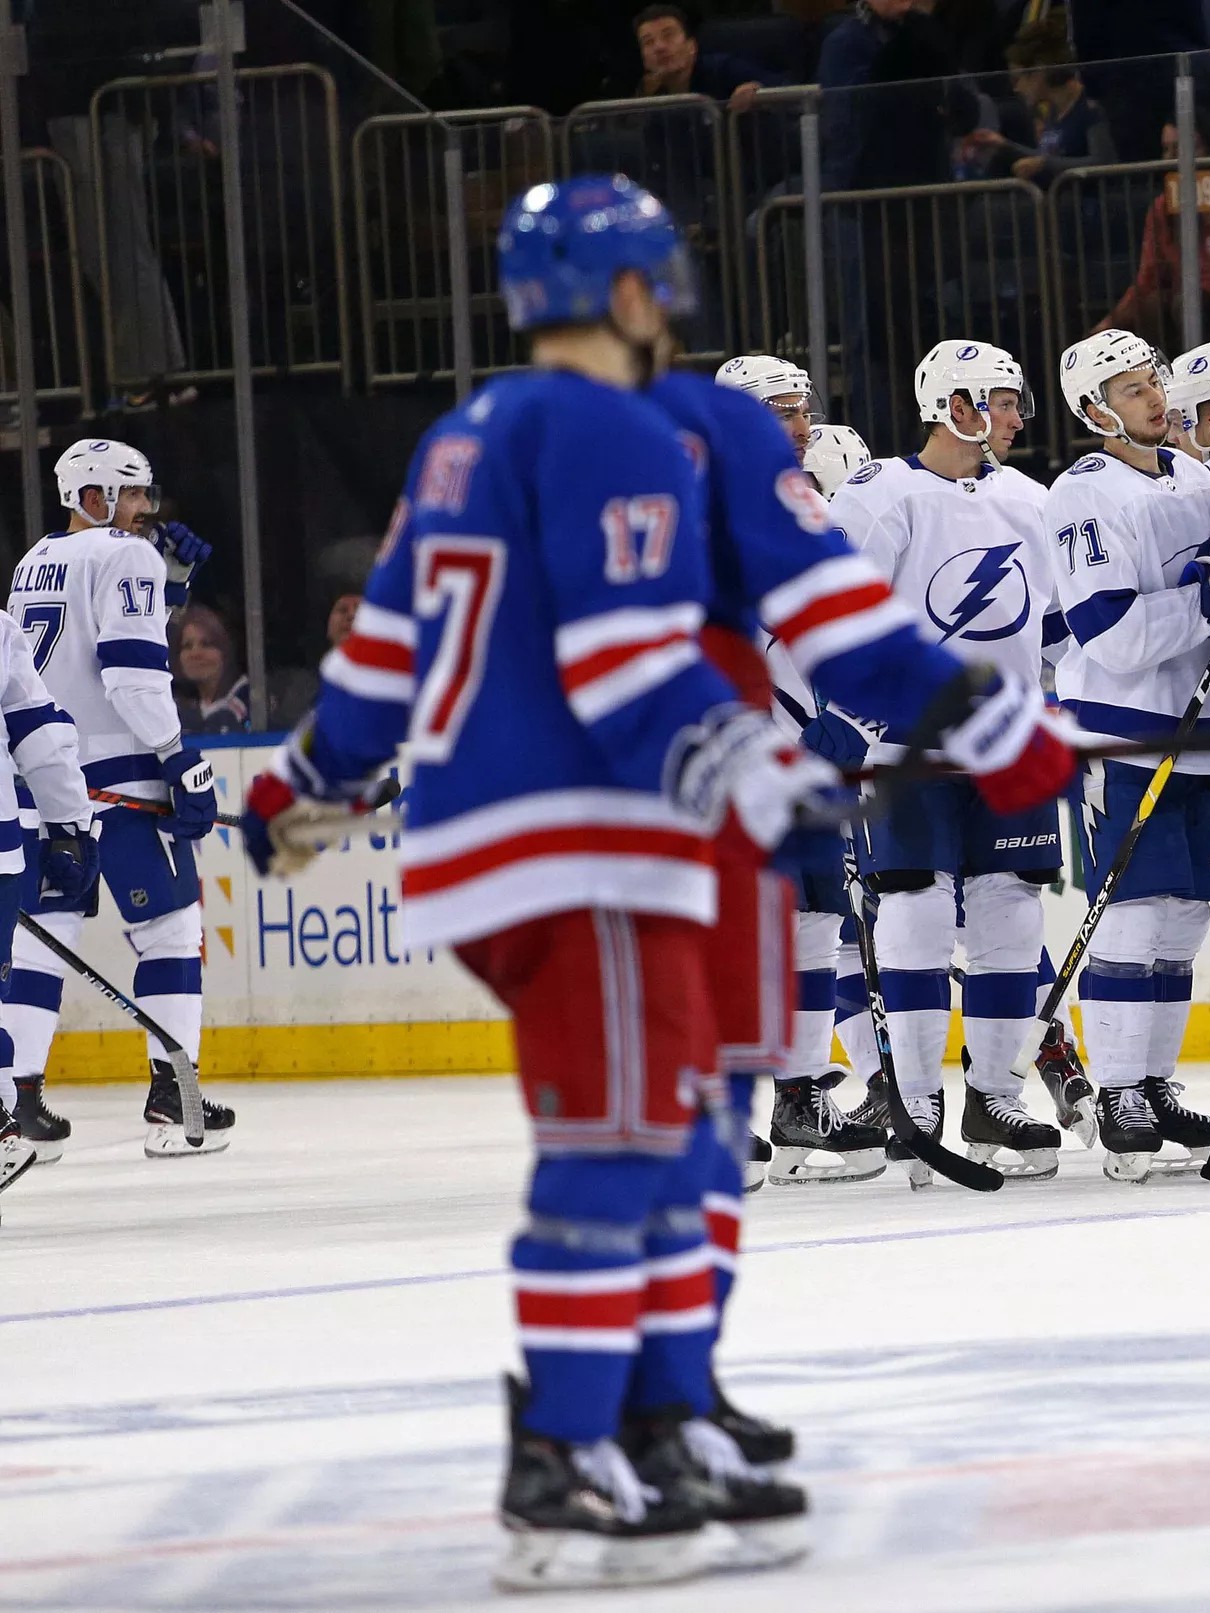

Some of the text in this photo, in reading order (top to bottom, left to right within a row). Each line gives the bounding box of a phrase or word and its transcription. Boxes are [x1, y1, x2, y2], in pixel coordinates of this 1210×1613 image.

[600, 493, 679, 584] 17
[1055, 518, 1109, 576] 71
[118, 577, 156, 617] 17
[994, 833, 1057, 850] BAUER
[257, 880, 434, 969] Healt
[1063, 942, 1082, 978] SUPER
[1079, 887, 1108, 945] TACKS
